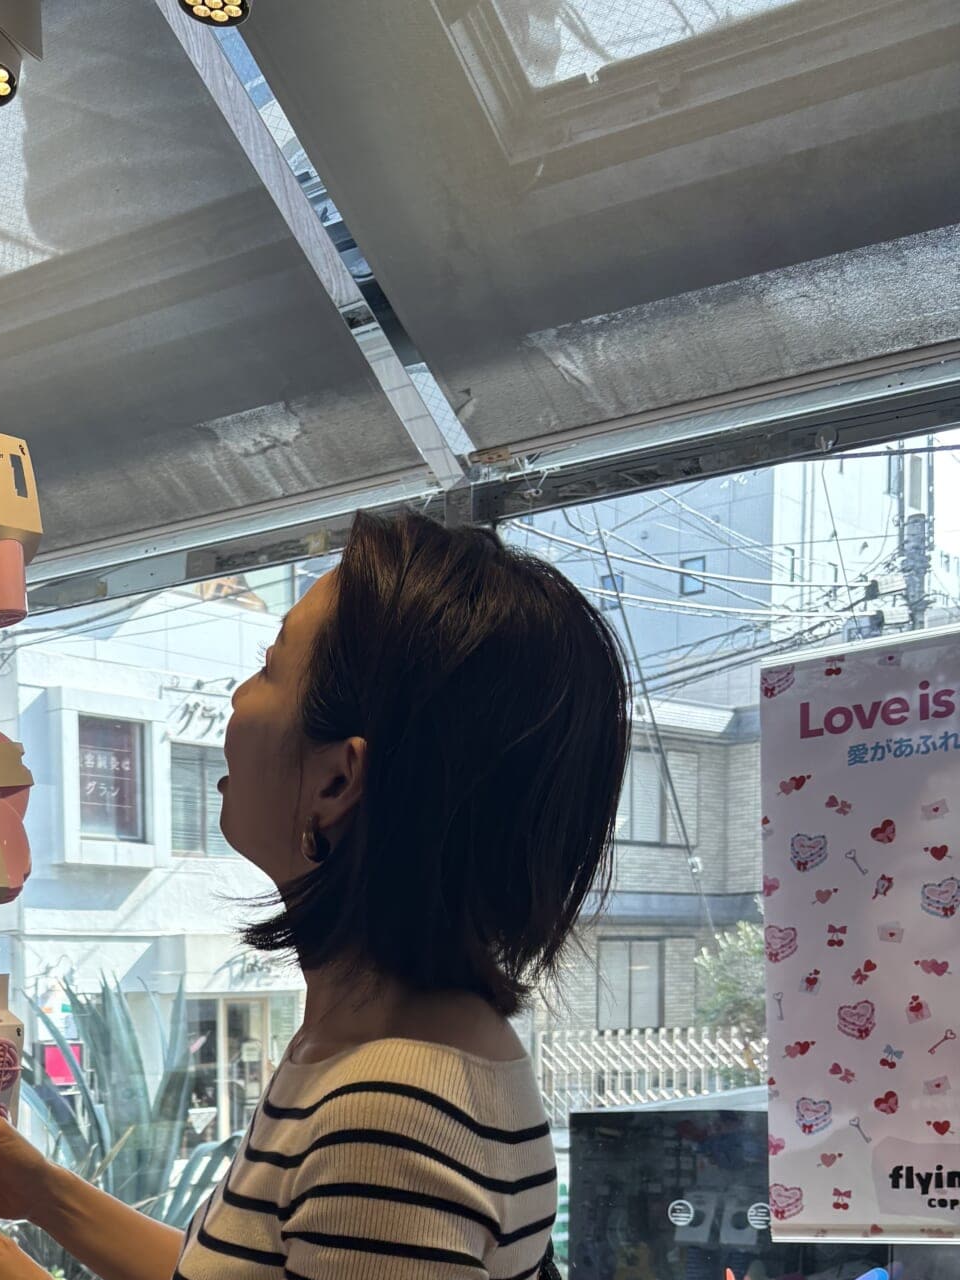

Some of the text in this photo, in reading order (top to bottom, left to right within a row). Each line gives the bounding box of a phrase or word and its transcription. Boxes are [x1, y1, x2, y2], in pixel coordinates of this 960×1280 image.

[800, 680, 956, 740] Love is
[847, 731, 960, 767] 愛があふれ
[85, 780, 121, 797] グラン
[927, 1198, 960, 1210] cop
